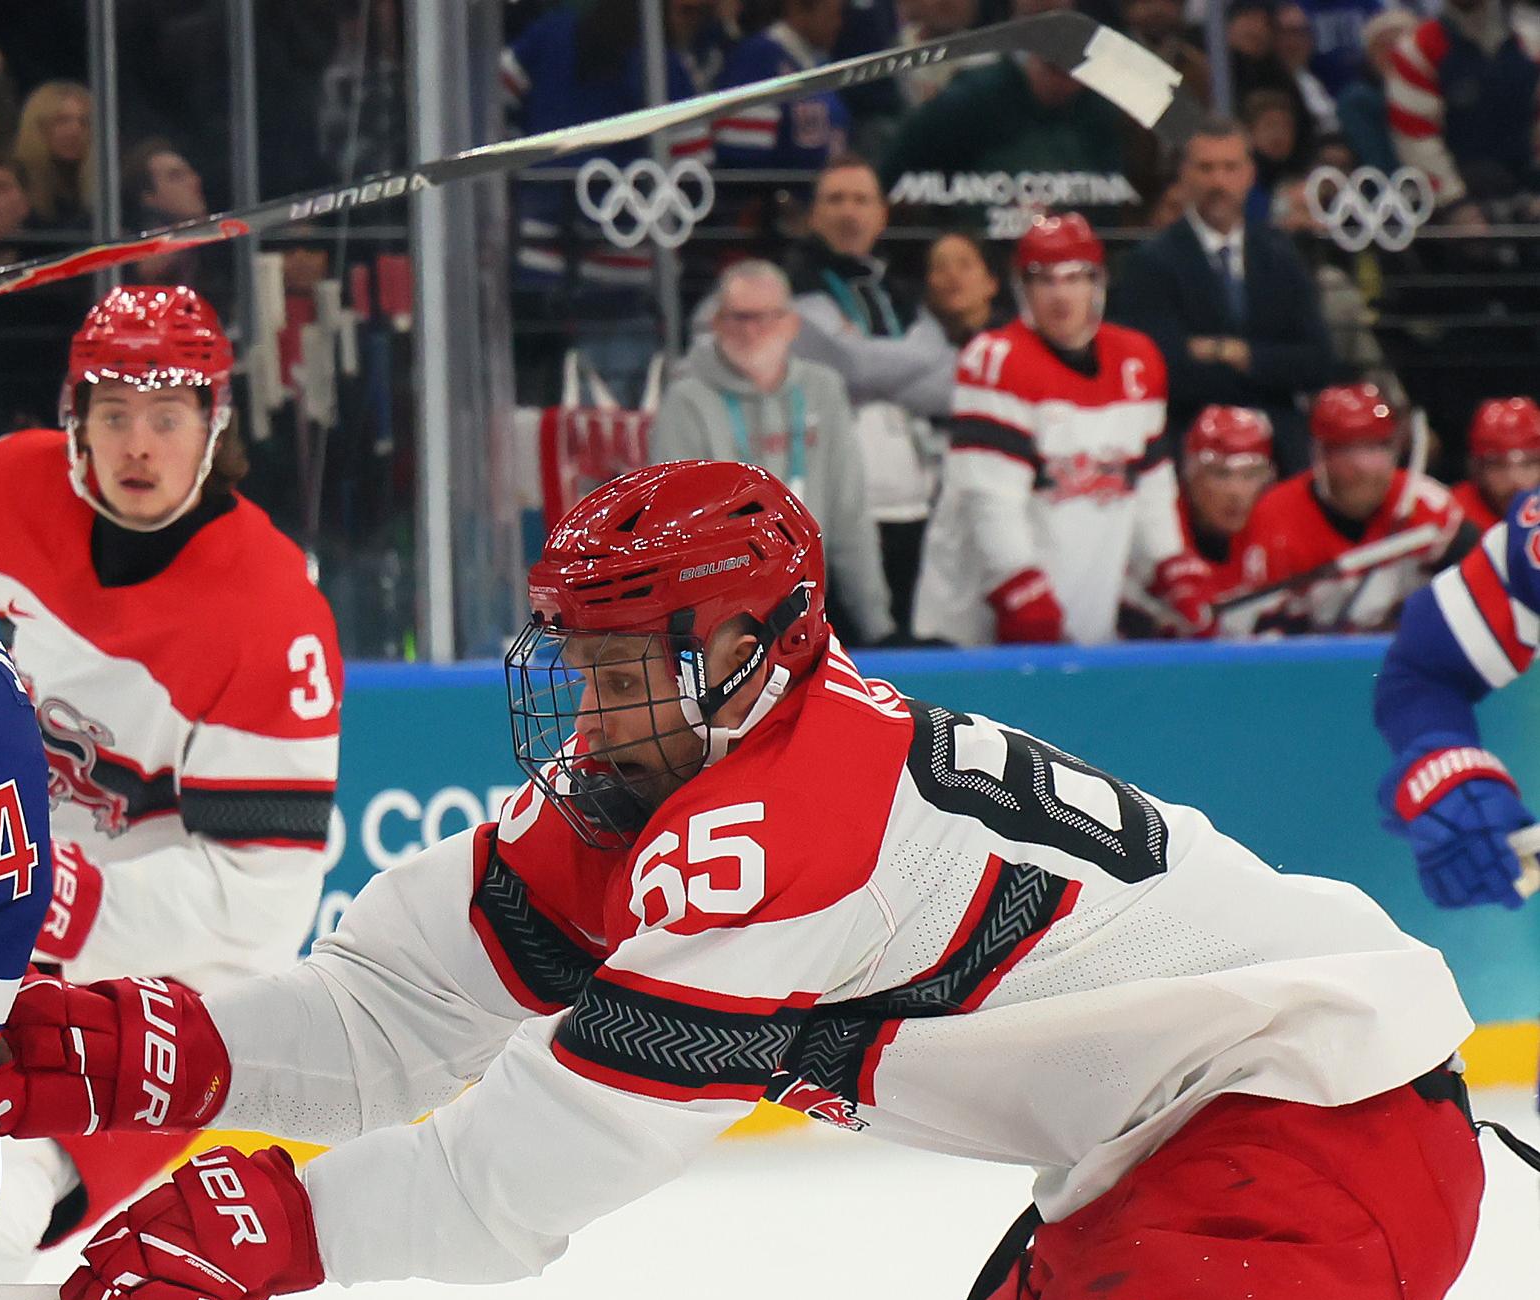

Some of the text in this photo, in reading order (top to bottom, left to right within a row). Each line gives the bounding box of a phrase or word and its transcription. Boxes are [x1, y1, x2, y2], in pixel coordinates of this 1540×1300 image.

[888, 170, 1143, 206] MILANO CORTINA
[679, 554, 750, 582] BAUER
[723, 644, 765, 695] BAUER
[629, 802, 766, 937] 65
